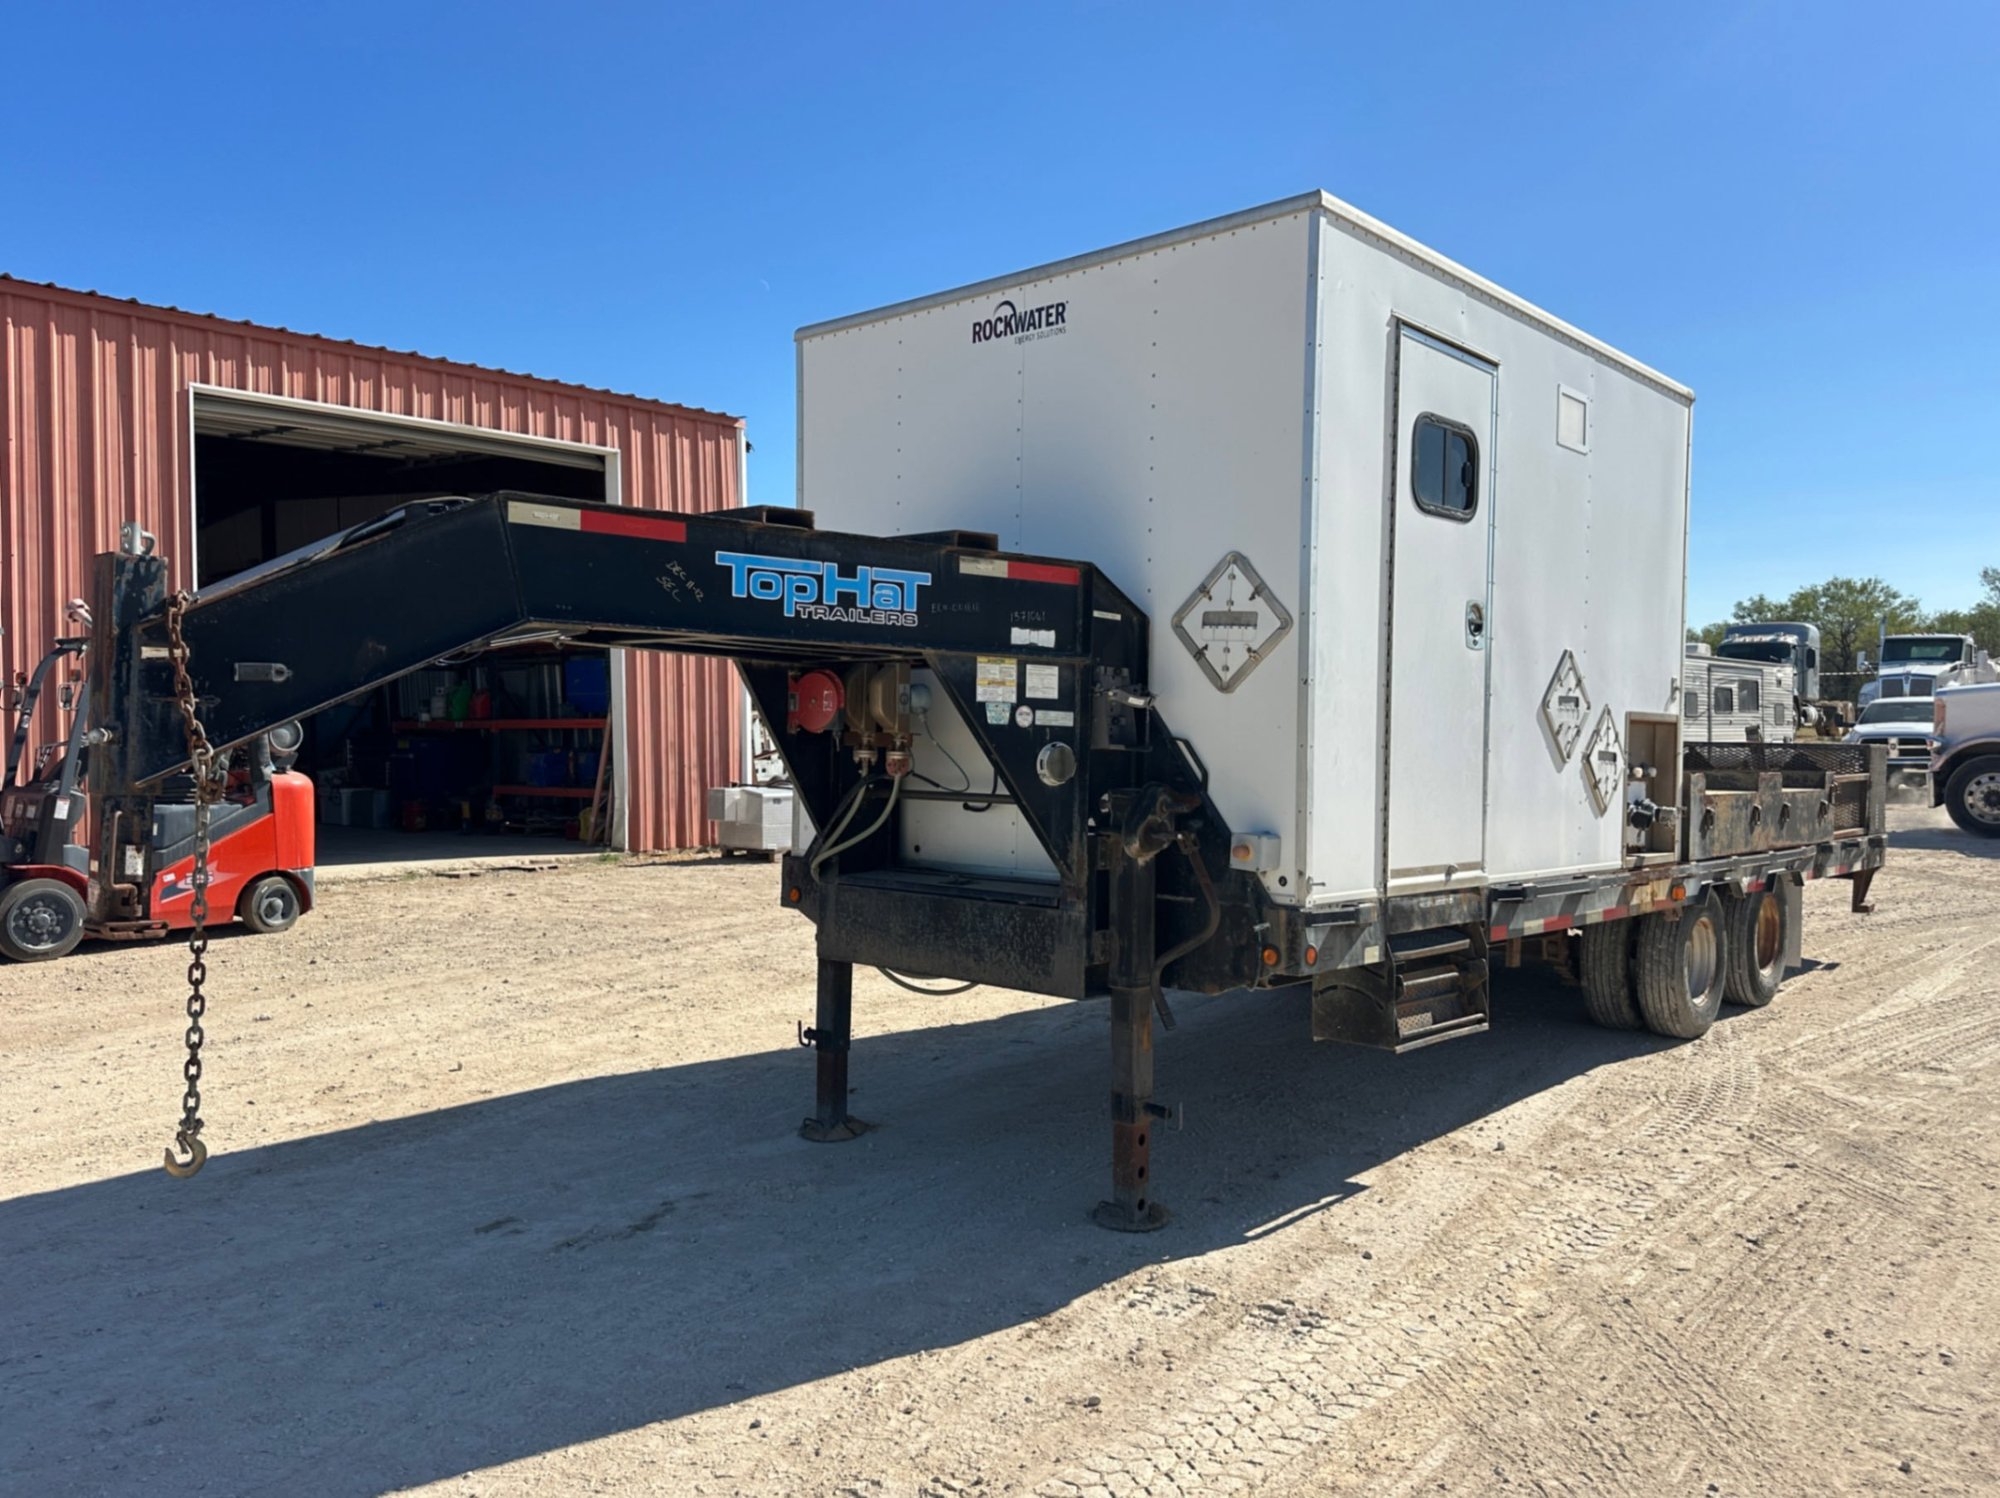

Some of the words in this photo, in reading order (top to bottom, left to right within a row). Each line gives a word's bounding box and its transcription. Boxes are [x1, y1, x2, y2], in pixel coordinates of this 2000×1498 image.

[972, 301, 1067, 344] ROCKWATER
[1014, 333, 1035, 345] ENERGY
[1036, 326, 1067, 341] SOLUTIONS
[796, 603, 919, 628] TRAILERS
